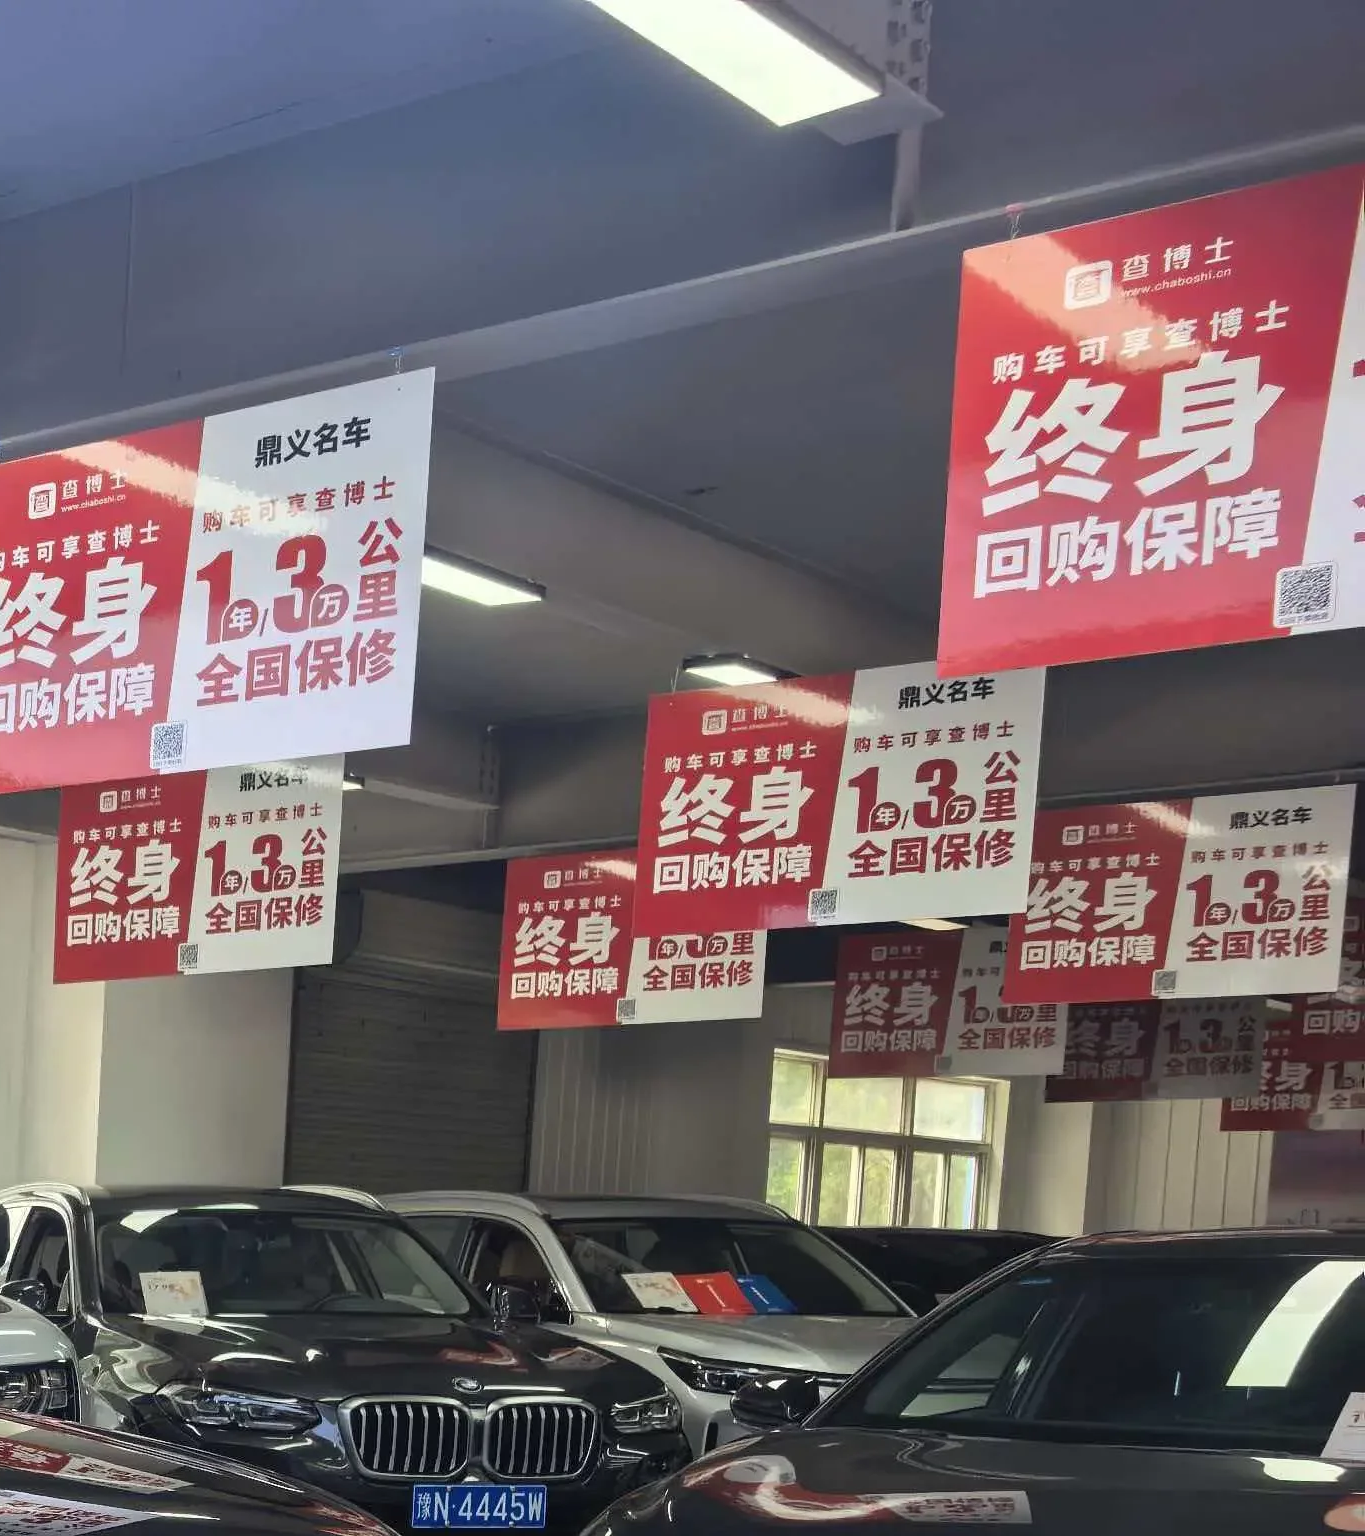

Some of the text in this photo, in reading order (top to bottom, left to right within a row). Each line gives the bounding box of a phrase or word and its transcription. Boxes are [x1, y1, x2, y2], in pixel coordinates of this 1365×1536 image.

[1121, 236, 1234, 282] 查博士
[992, 300, 1290, 385] 购车可享查博士
[253, 417, 371, 468] 鼎义名车
[981, 350, 1285, 518] 终身
[61, 471, 128, 500] 查博士
[202, 475, 397, 534] 购车可享查博士
[973, 488, 1282, 599] 回购保障
[196, 628, 397, 707] 全国保修
[898, 677, 995, 710] 鼎义名车
[853, 720, 1015, 754] 购车可享查博士
[664, 741, 817, 773] 购车可享查博士
[208, 802, 324, 831] 购车可享查博士
[658, 766, 815, 848] 终身
[1229, 806, 1313, 830] 鼎义名车
[73, 817, 183, 845] 购车可享查博士
[653, 844, 813, 894] 回购保障
[847, 828, 1016, 878] 全国保修
[1030, 852, 1161, 875] 购车可享查博士
[1190, 841, 1329, 864] 购车可享查博士
[69, 839, 181, 908] 终身
[204, 893, 324, 935] 全国保修
[518, 895, 622, 914] 购车可享查博士
[1025, 871, 1158, 934] 终身
[66, 904, 181, 947] 回购保障
[514, 911, 620, 967] 终身
[1186, 926, 1328, 963] 全国保修
[1020, 934, 1156, 971] 回购保障
[511, 966, 619, 999] 回购保障
[643, 959, 754, 992] 全国保修
[844, 981, 938, 1027] 终身
[841, 1029, 937, 1053] 回购保障
[958, 1026, 1056, 1050] 全国保修
